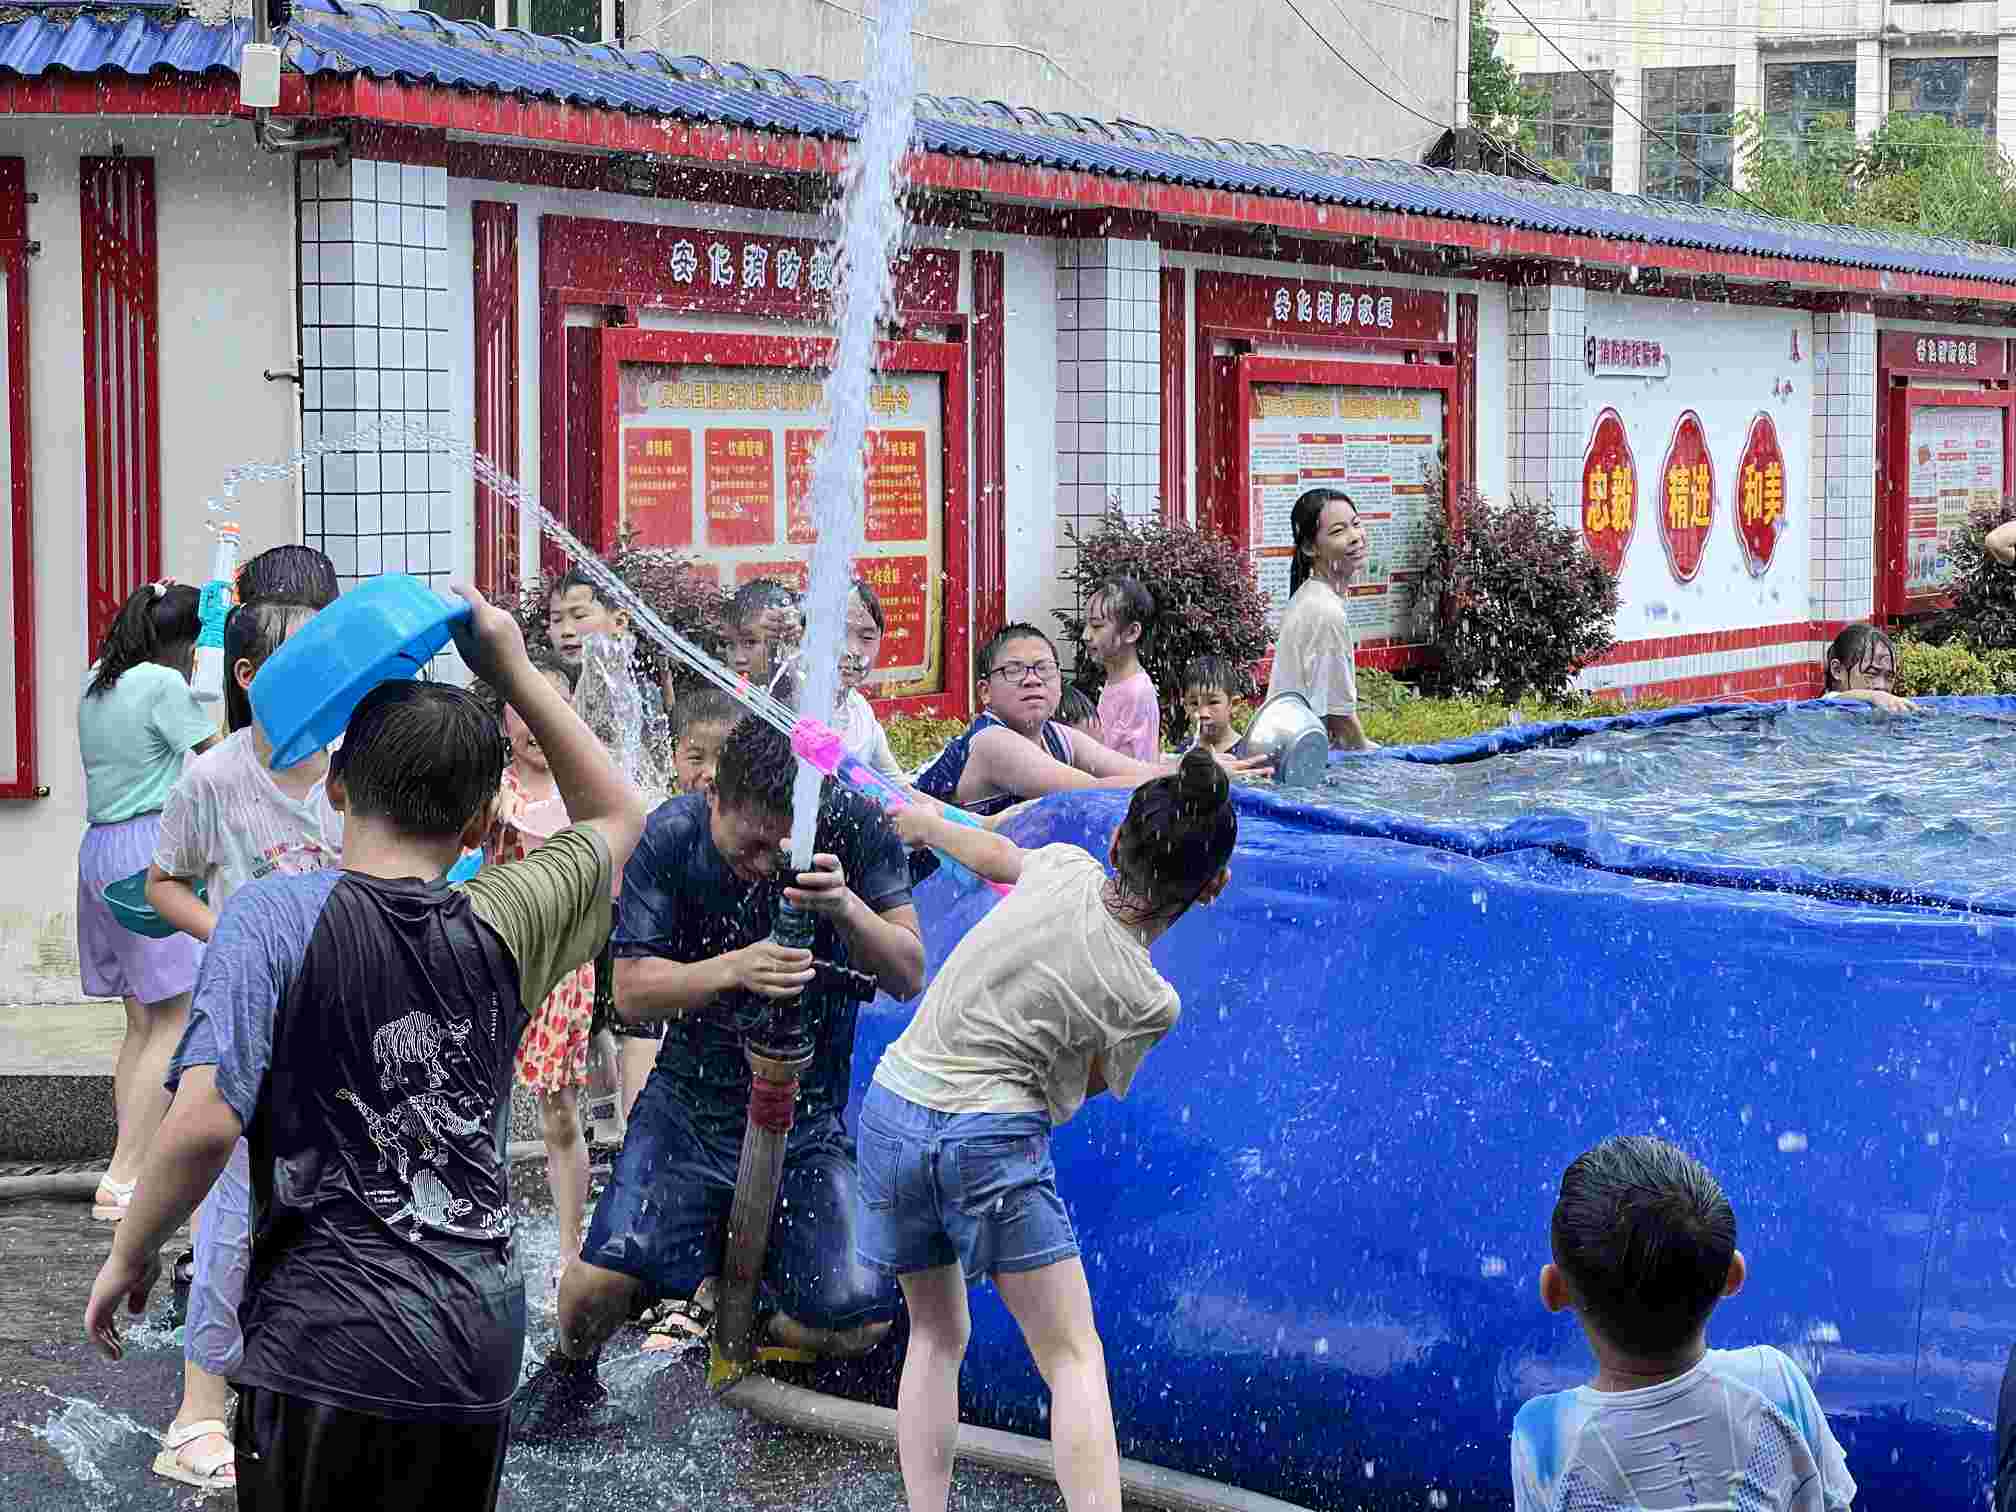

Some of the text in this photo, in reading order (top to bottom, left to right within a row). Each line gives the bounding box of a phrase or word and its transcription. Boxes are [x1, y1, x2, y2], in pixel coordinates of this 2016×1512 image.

[671, 239, 842, 289] 安化消防救
[1666, 463, 1711, 529] 精进
[1743, 462, 1785, 526] 和美
